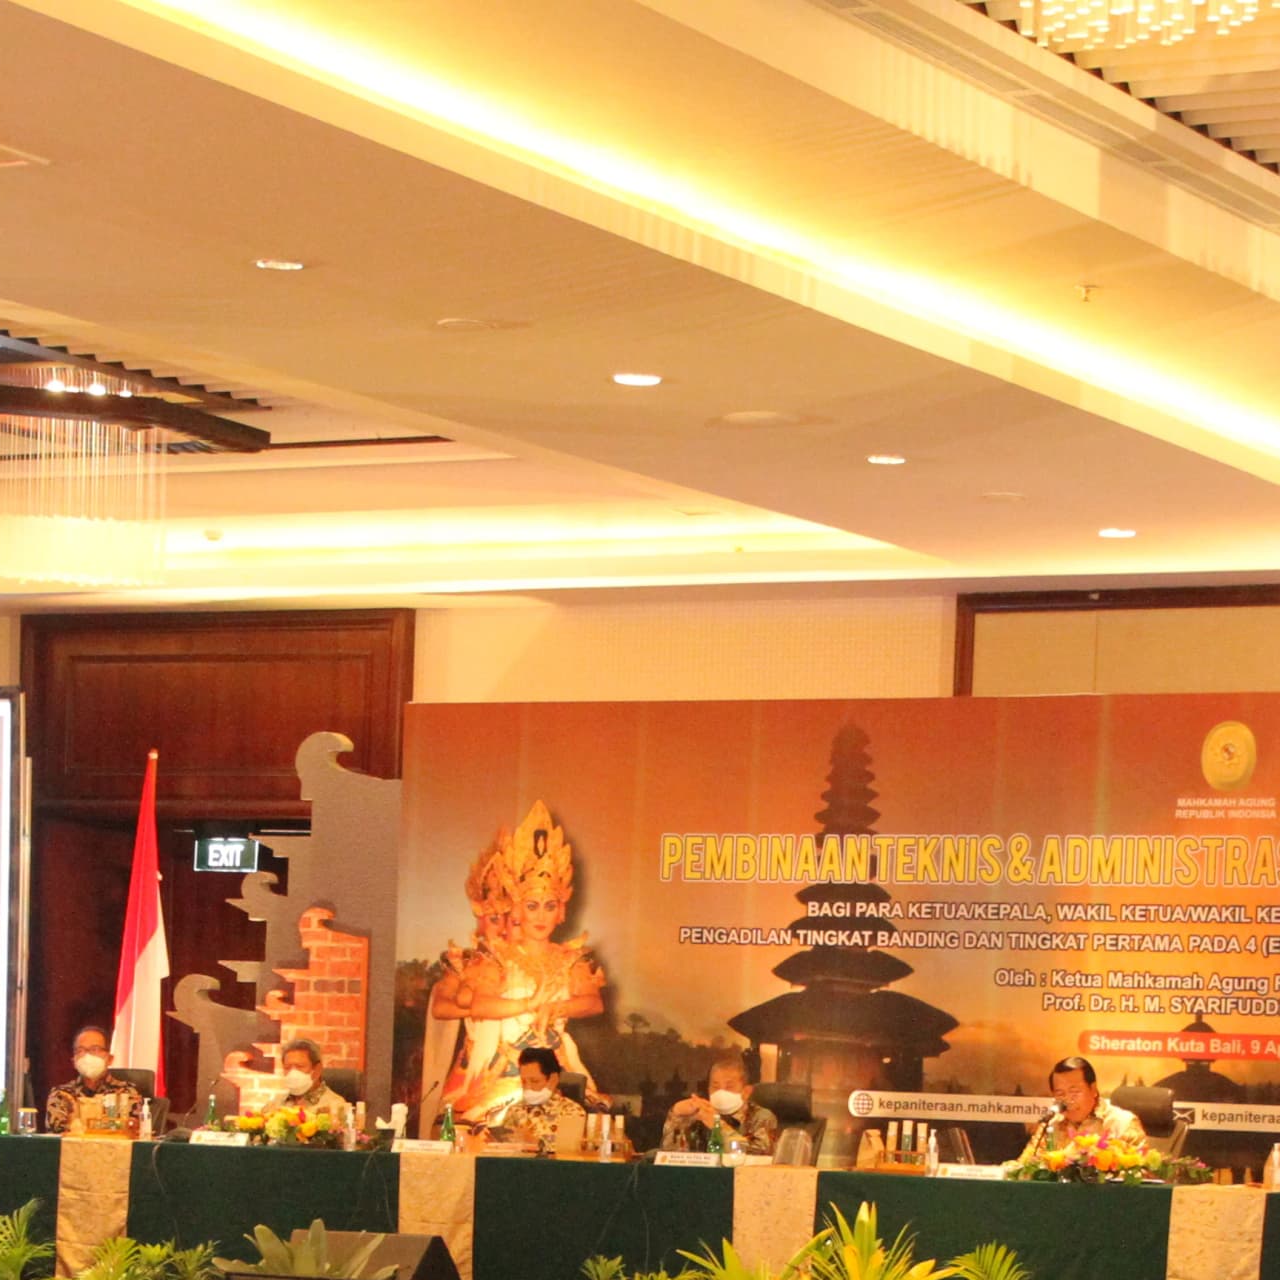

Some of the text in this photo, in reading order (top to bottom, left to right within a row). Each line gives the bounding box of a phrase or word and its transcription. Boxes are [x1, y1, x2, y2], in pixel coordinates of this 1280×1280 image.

[1177, 798, 1276, 807] MAHKAMAH AGUNG
[1175, 809, 1224, 818] REPUBLIK
[208, 844, 244, 867] EXIT
[661, 833, 869, 884] PEMBINAAN
[873, 833, 1004, 886] TEKNIS
[1006, 833, 1036, 886] &
[807, 901, 851, 918] BAGI
[855, 902, 904, 918] PARA
[907, 903, 1052, 922] KETUA/KEPALA,
[1056, 904, 1117, 921] WAKIL
[1121, 905, 1252, 923] KETUA/WAKIL
[679, 926, 792, 945] PENGADILAN
[796, 929, 872, 946] TINGKAT
[876, 930, 960, 948] BANDING
[963, 931, 1003, 949] DAN
[1008, 932, 1088, 950] TINGKAT
[1092, 933, 1182, 951] PERTAMA
[1188, 935, 1240, 952] PADA
[1245, 935, 1257, 952] 4
[995, 968, 1035, 986] Oleh
[1051, 971, 1102, 988] Ketua
[1108, 972, 1203, 990] Mahkamah
[1207, 974, 1270, 994] Agung
[1043, 994, 1085, 1011] Prof.
[1090, 995, 1115, 1012] Dr.
[1121, 996, 1140, 1012] H.
[1144, 996, 1165, 1013] M.
[1089, 1035, 1163, 1053] Sheraton
[1167, 1037, 1205, 1053] Kuta
[1209, 1038, 1247, 1056] Bali,
[1250, 1039, 1260, 1054] 9
[878, 1098, 1049, 1116] kepaniteraan.mahkamaha
